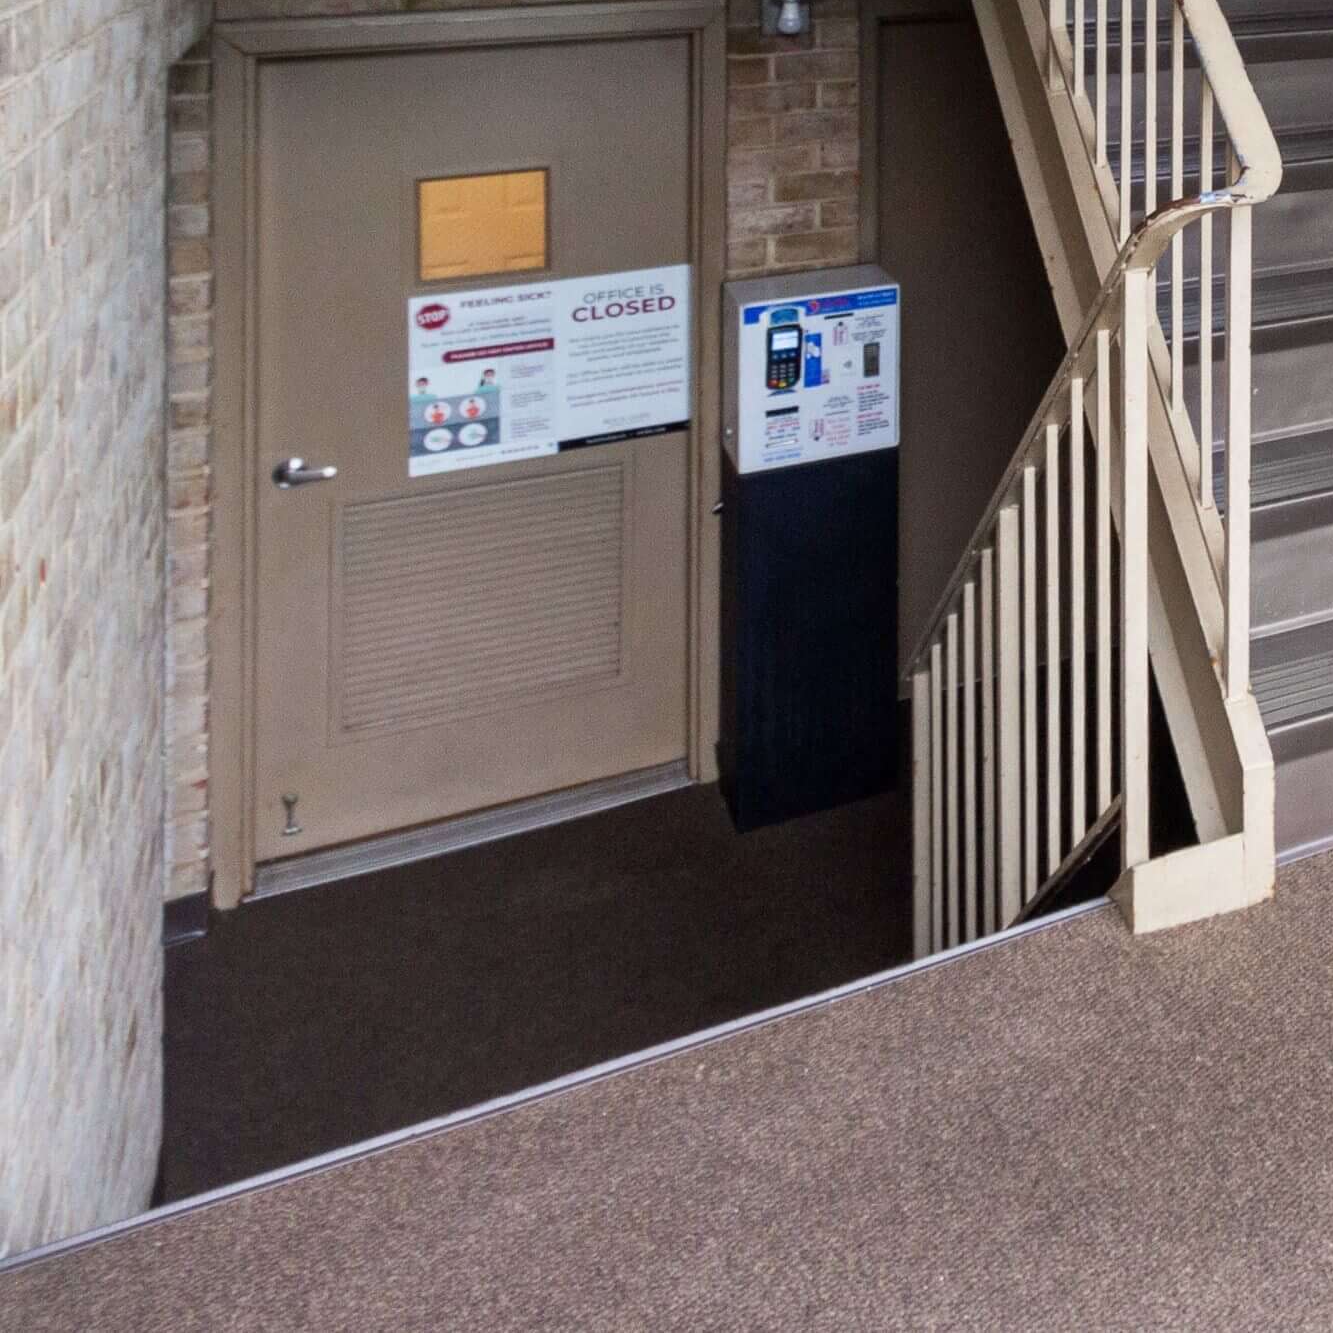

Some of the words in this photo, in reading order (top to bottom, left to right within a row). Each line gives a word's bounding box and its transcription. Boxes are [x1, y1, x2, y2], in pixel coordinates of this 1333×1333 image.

[459, 295, 514, 308] FEELING
[582, 286, 645, 304] OFFICE
[649, 283, 665, 296] IS
[416, 309, 449, 326] STOP
[571, 295, 676, 323] CLOSED
